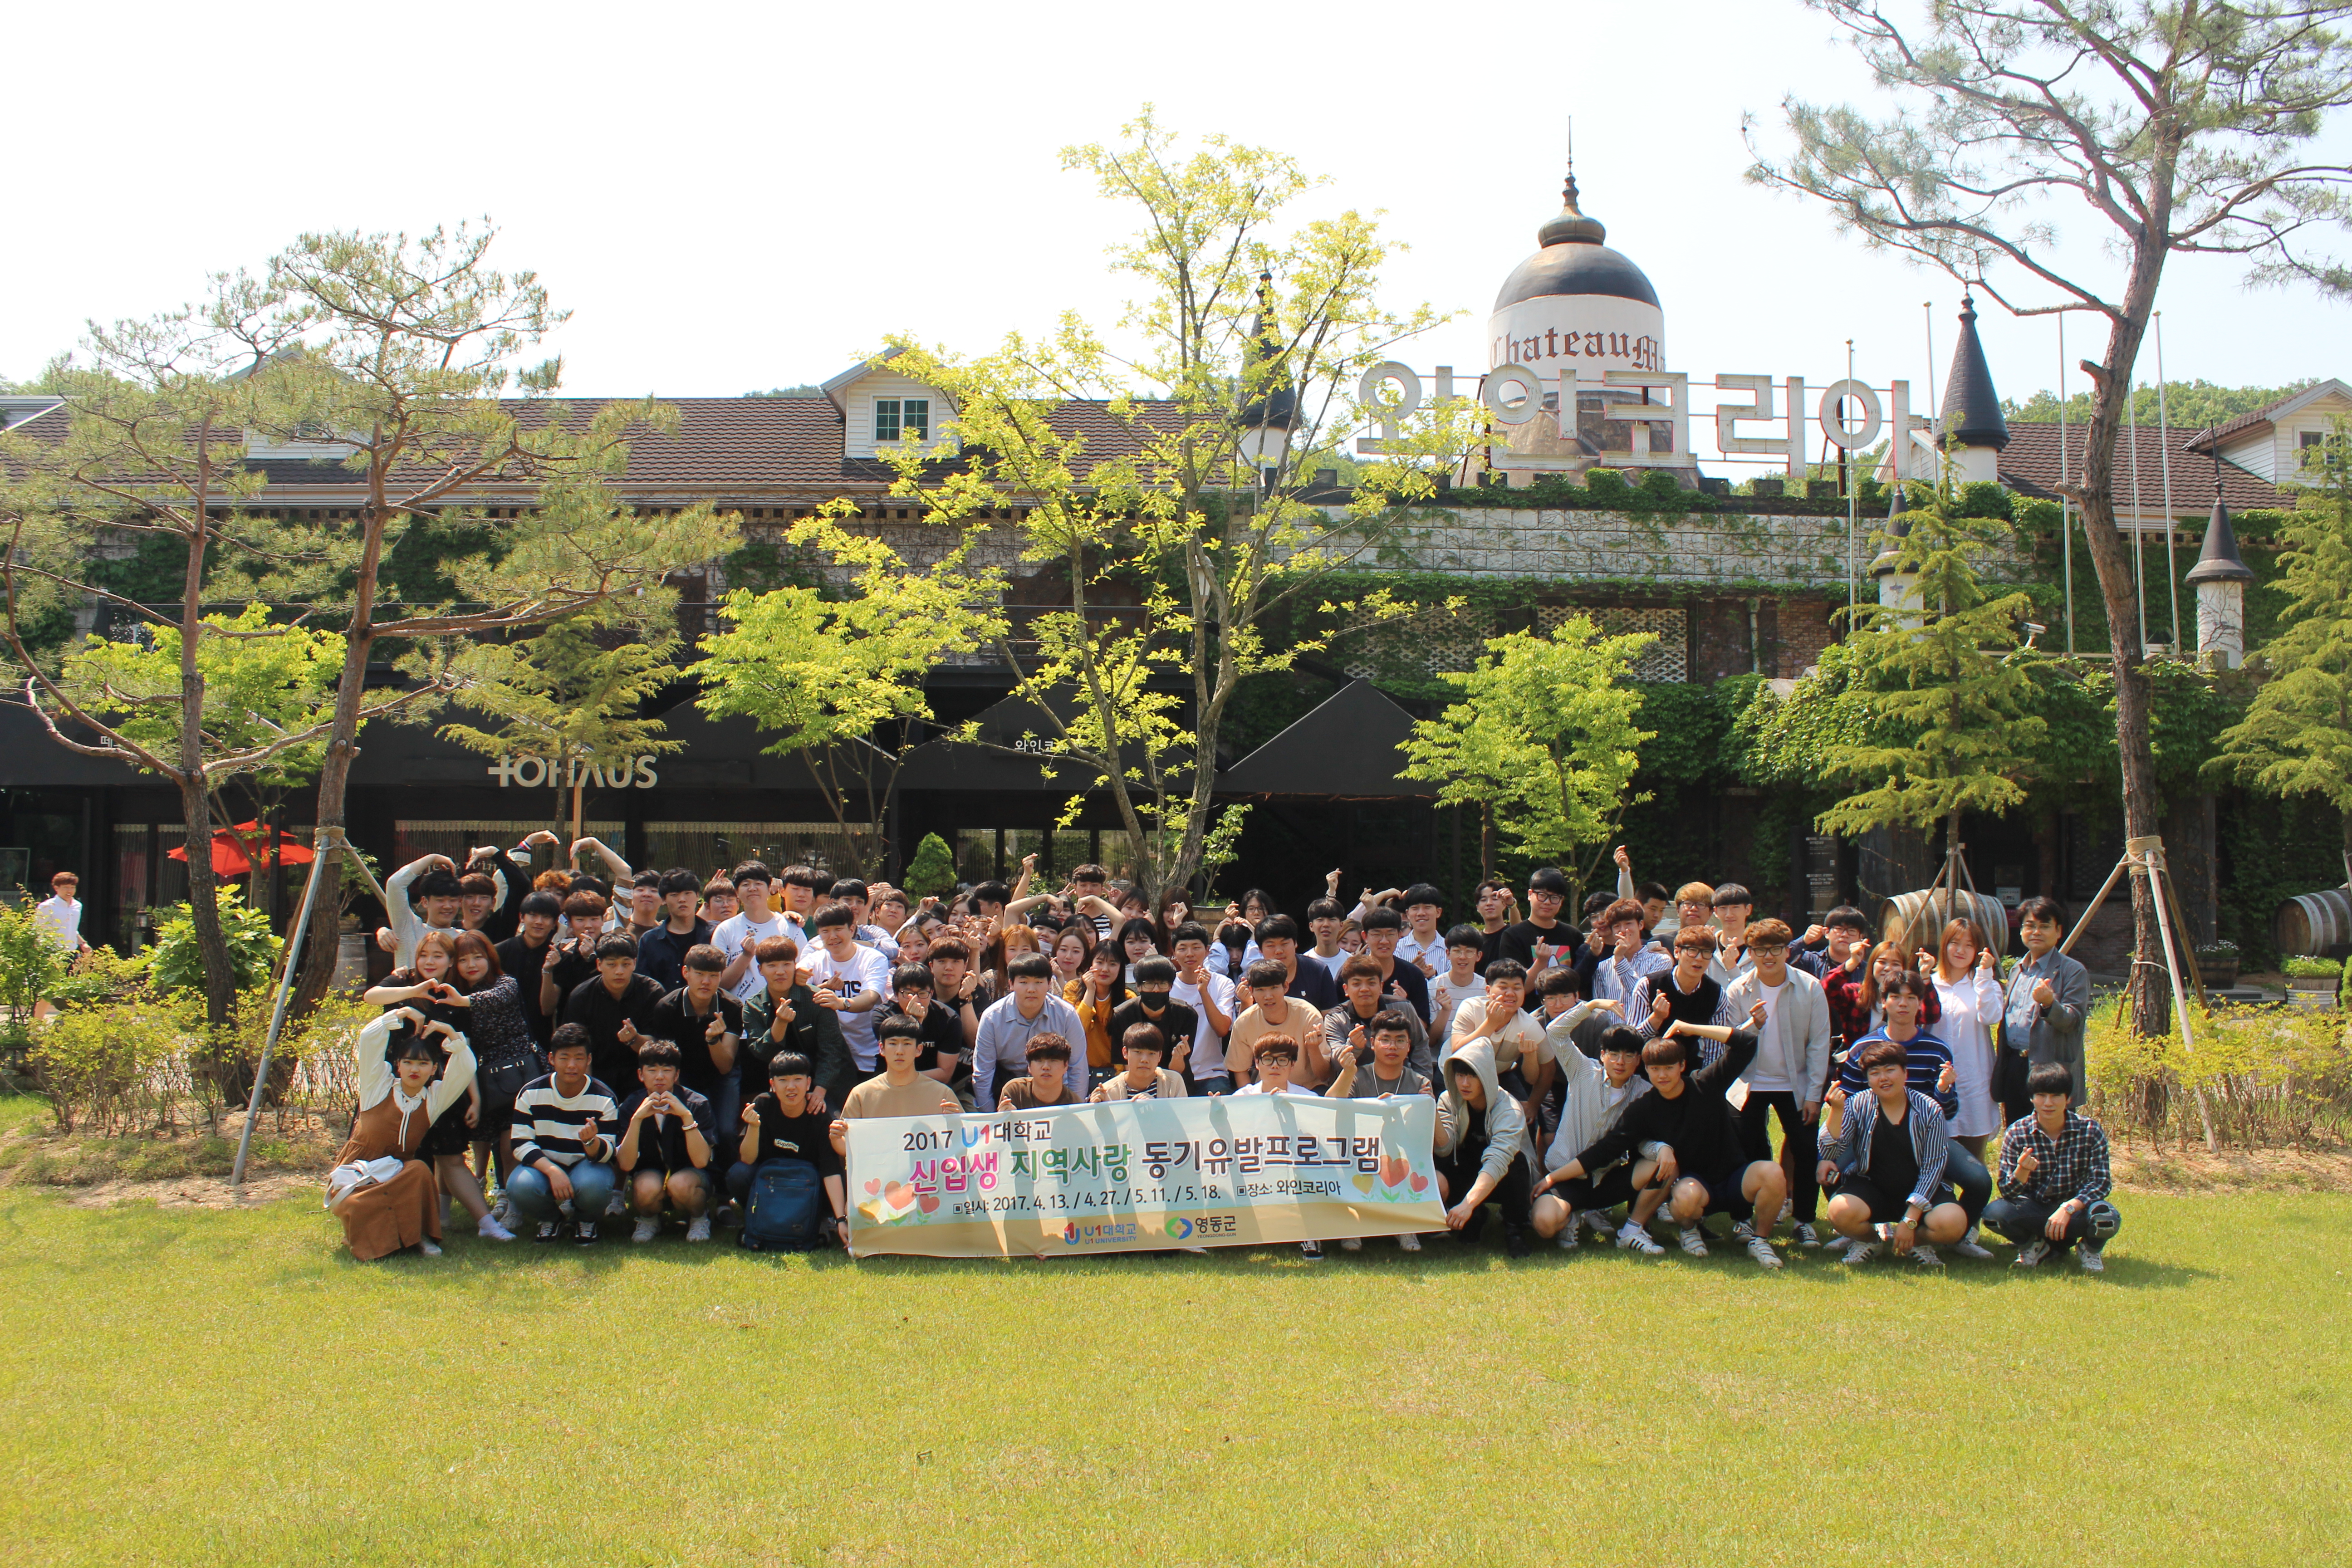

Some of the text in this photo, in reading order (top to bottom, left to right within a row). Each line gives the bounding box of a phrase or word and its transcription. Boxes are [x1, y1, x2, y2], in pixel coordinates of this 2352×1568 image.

[1357, 361, 1923, 480] 와인코리아
[903, 1120, 1052, 1151] 2017 U1대학교
[909, 1136, 1381, 1193] 신입생 지역사랑 동기유발프로그램
[964, 1200, 990, 1215] 일시:
[1248, 1182, 1273, 1197] 장소:
[1276, 1179, 1341, 1196] 와인코리아
[1084, 1223, 1137, 1236] U1대학교
[1095, 1235, 1137, 1244] UNIVERSITY
[1195, 1215, 1236, 1234] 영동군
